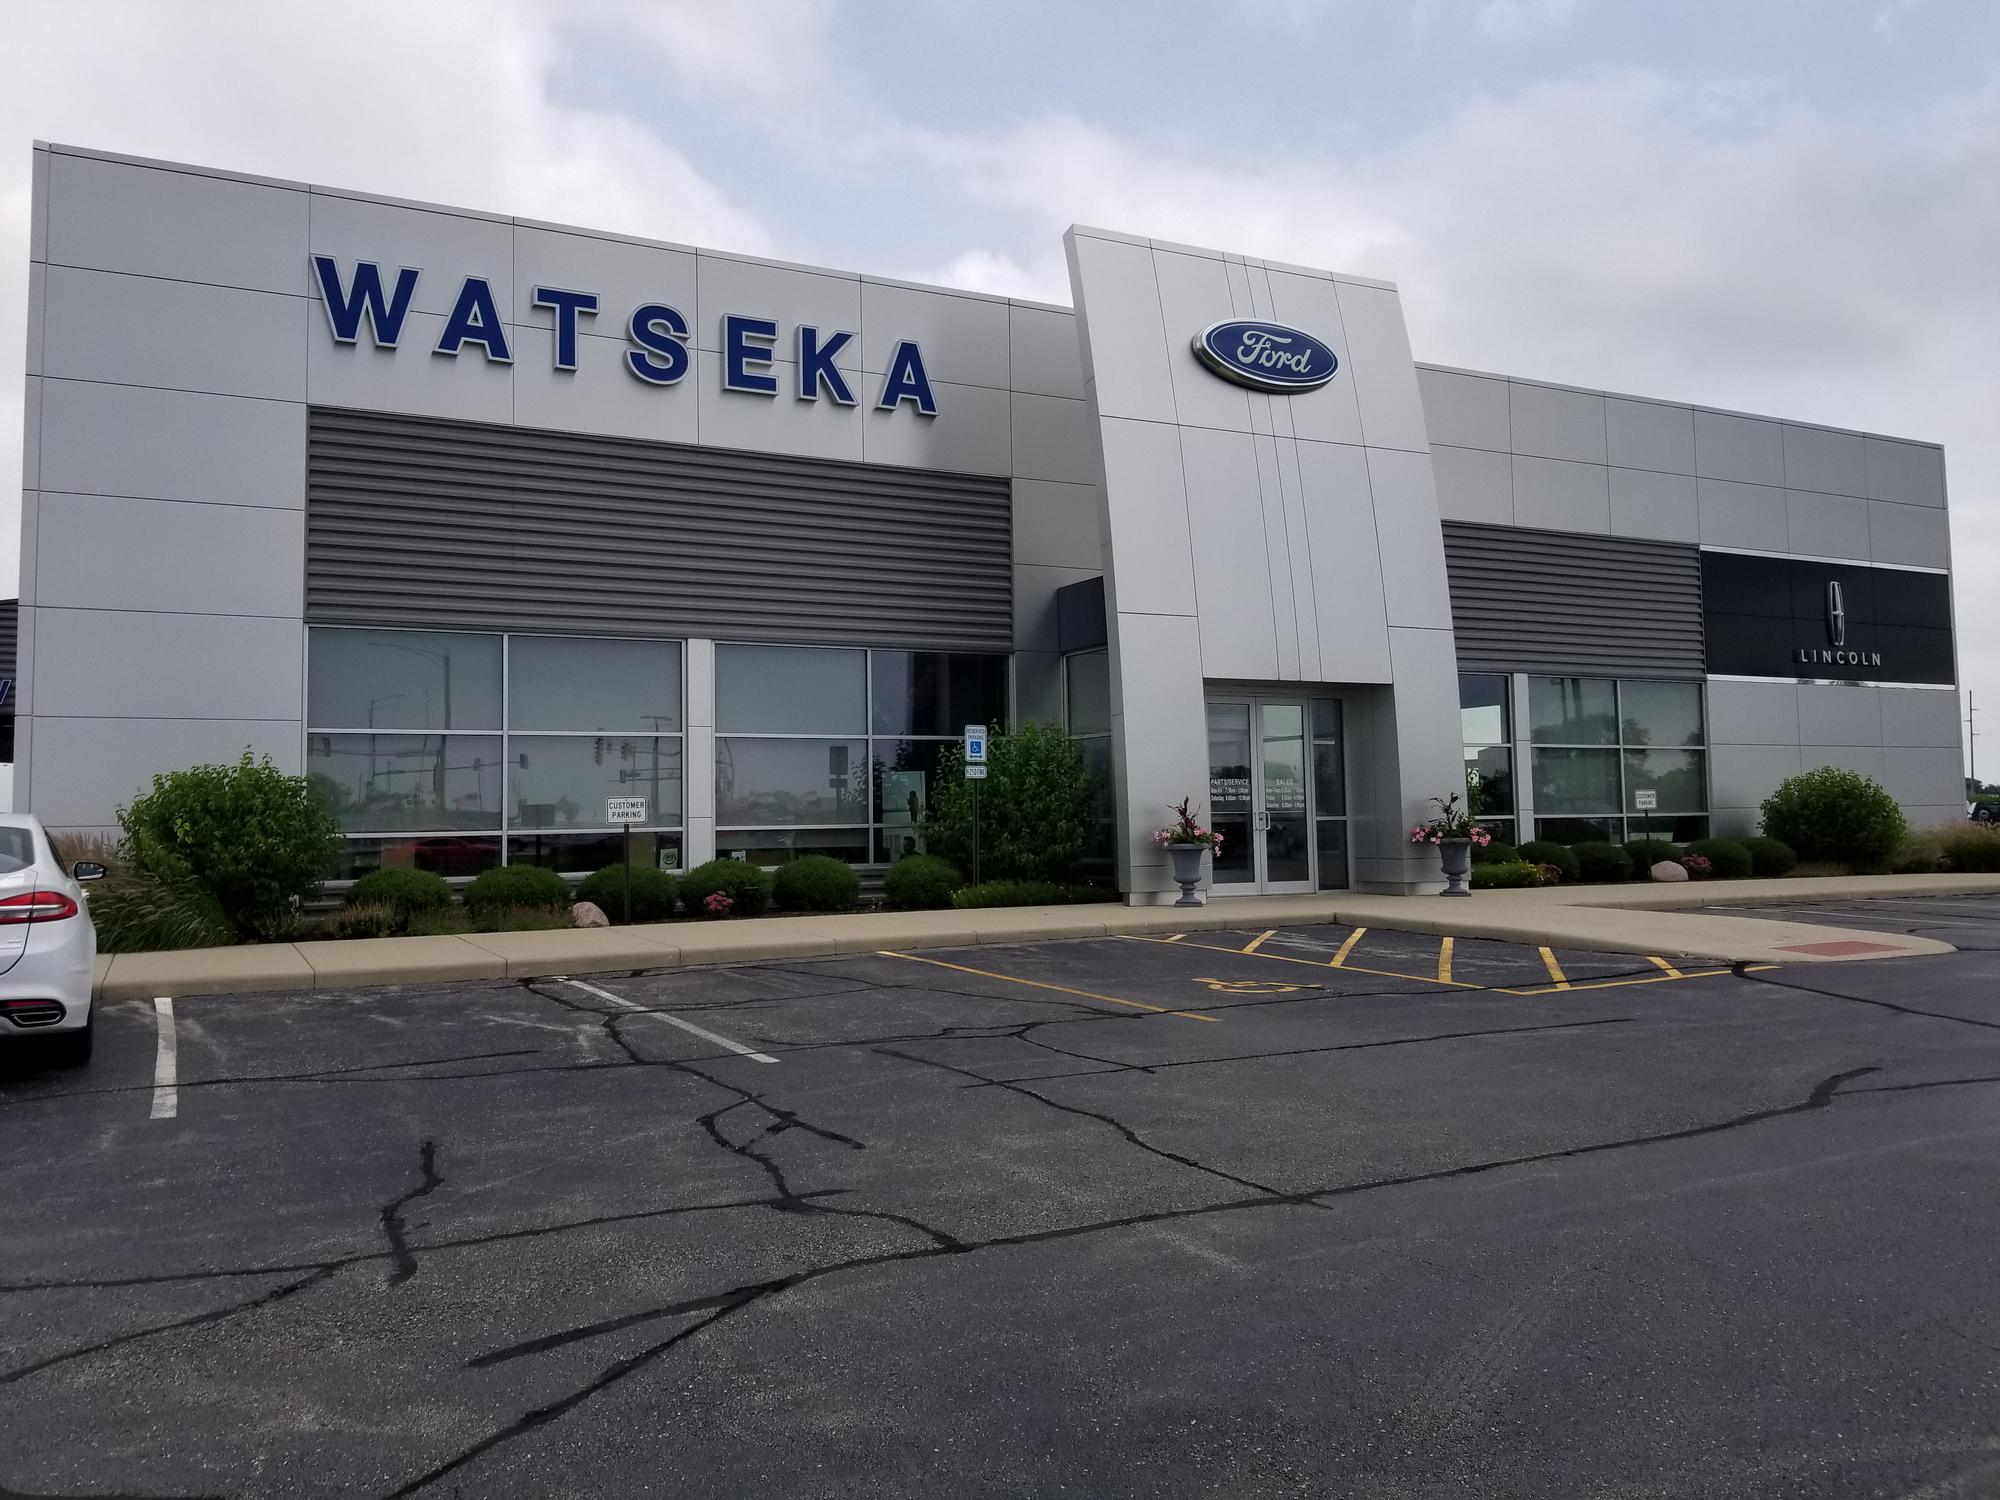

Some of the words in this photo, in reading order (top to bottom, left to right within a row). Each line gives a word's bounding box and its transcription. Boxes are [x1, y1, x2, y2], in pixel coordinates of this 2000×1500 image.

[311, 254, 938, 416] WATSEKA
[1237, 331, 1311, 373] Ford
[1800, 649, 1881, 666] LINCOLN
[609, 801, 645, 809] CUSTOMER
